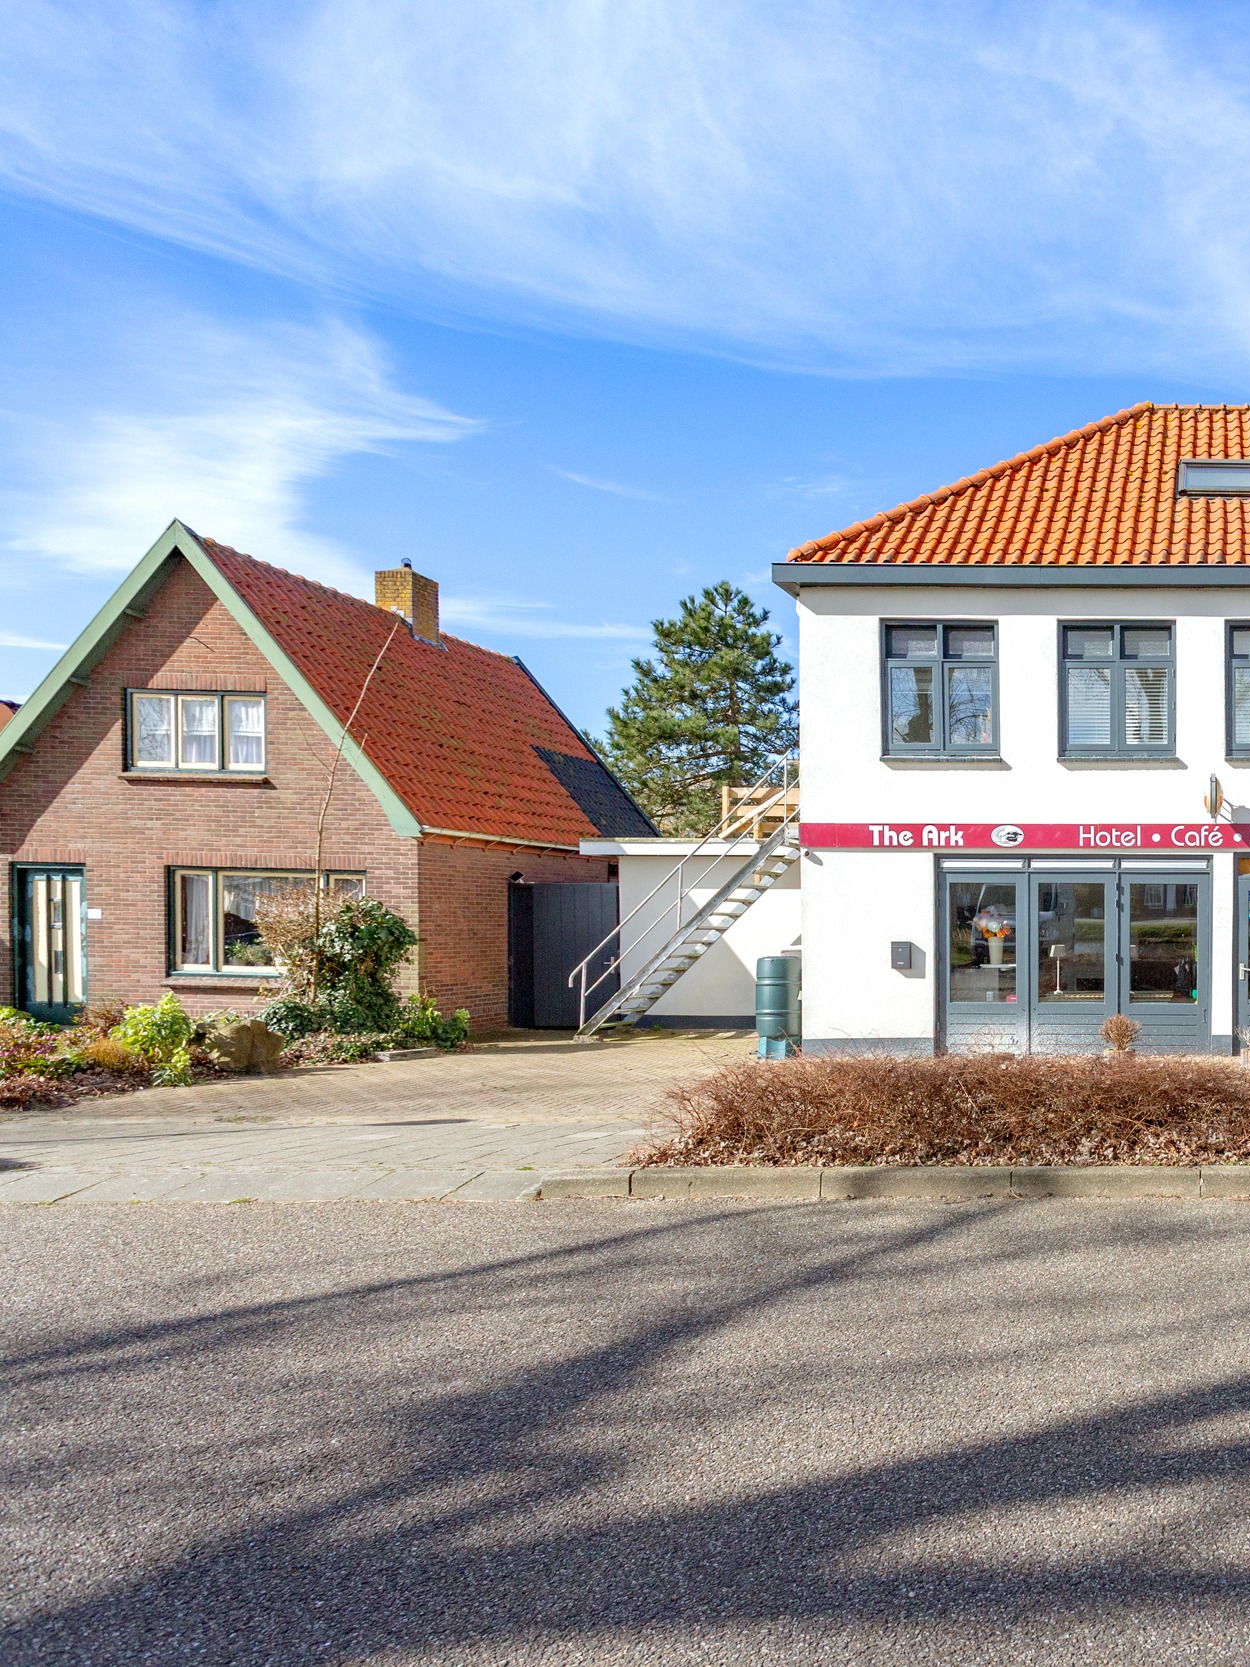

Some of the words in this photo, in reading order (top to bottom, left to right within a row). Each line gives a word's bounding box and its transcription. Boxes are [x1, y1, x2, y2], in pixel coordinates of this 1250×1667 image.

[868, 825, 914, 847] The
[922, 824, 964, 847] Ark
[1079, 825, 1142, 847] Hotel
[1170, 825, 1224, 847] Café
